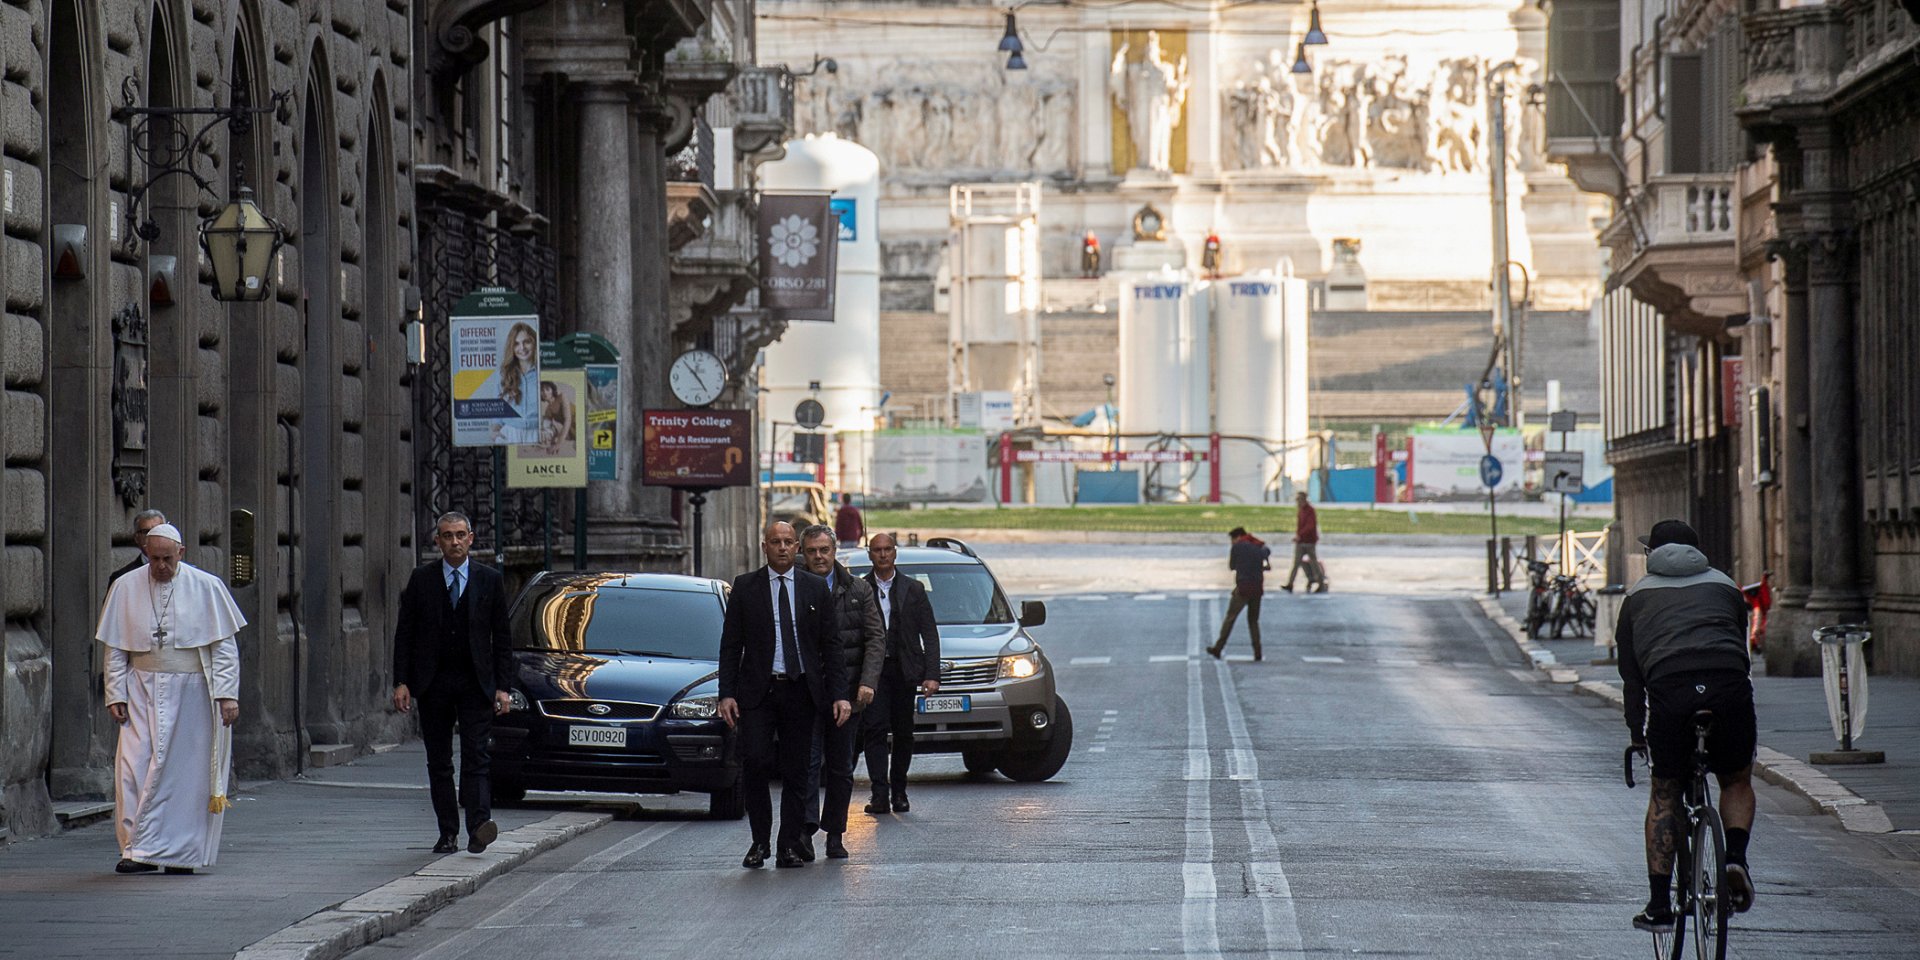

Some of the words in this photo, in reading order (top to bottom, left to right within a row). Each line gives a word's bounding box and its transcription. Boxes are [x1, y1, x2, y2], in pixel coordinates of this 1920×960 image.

[761, 277, 804, 289] CORSO
[805, 277, 826, 289] 281
[1134, 286, 1182, 299] TREVI
[1230, 283, 1277, 296] TREVI
[460, 327, 496, 337] DIFFERENT
[461, 353, 497, 367] FUTURE
[672, 373, 679, 382] 9
[694, 393, 702, 403] 6
[649, 416, 688, 428] Trinity
[691, 416, 732, 428] College
[660, 436, 676, 444] Pub
[678, 436, 686, 444] &
[687, 436, 731, 444] Restaurant
[526, 465, 568, 474] LANCEL
